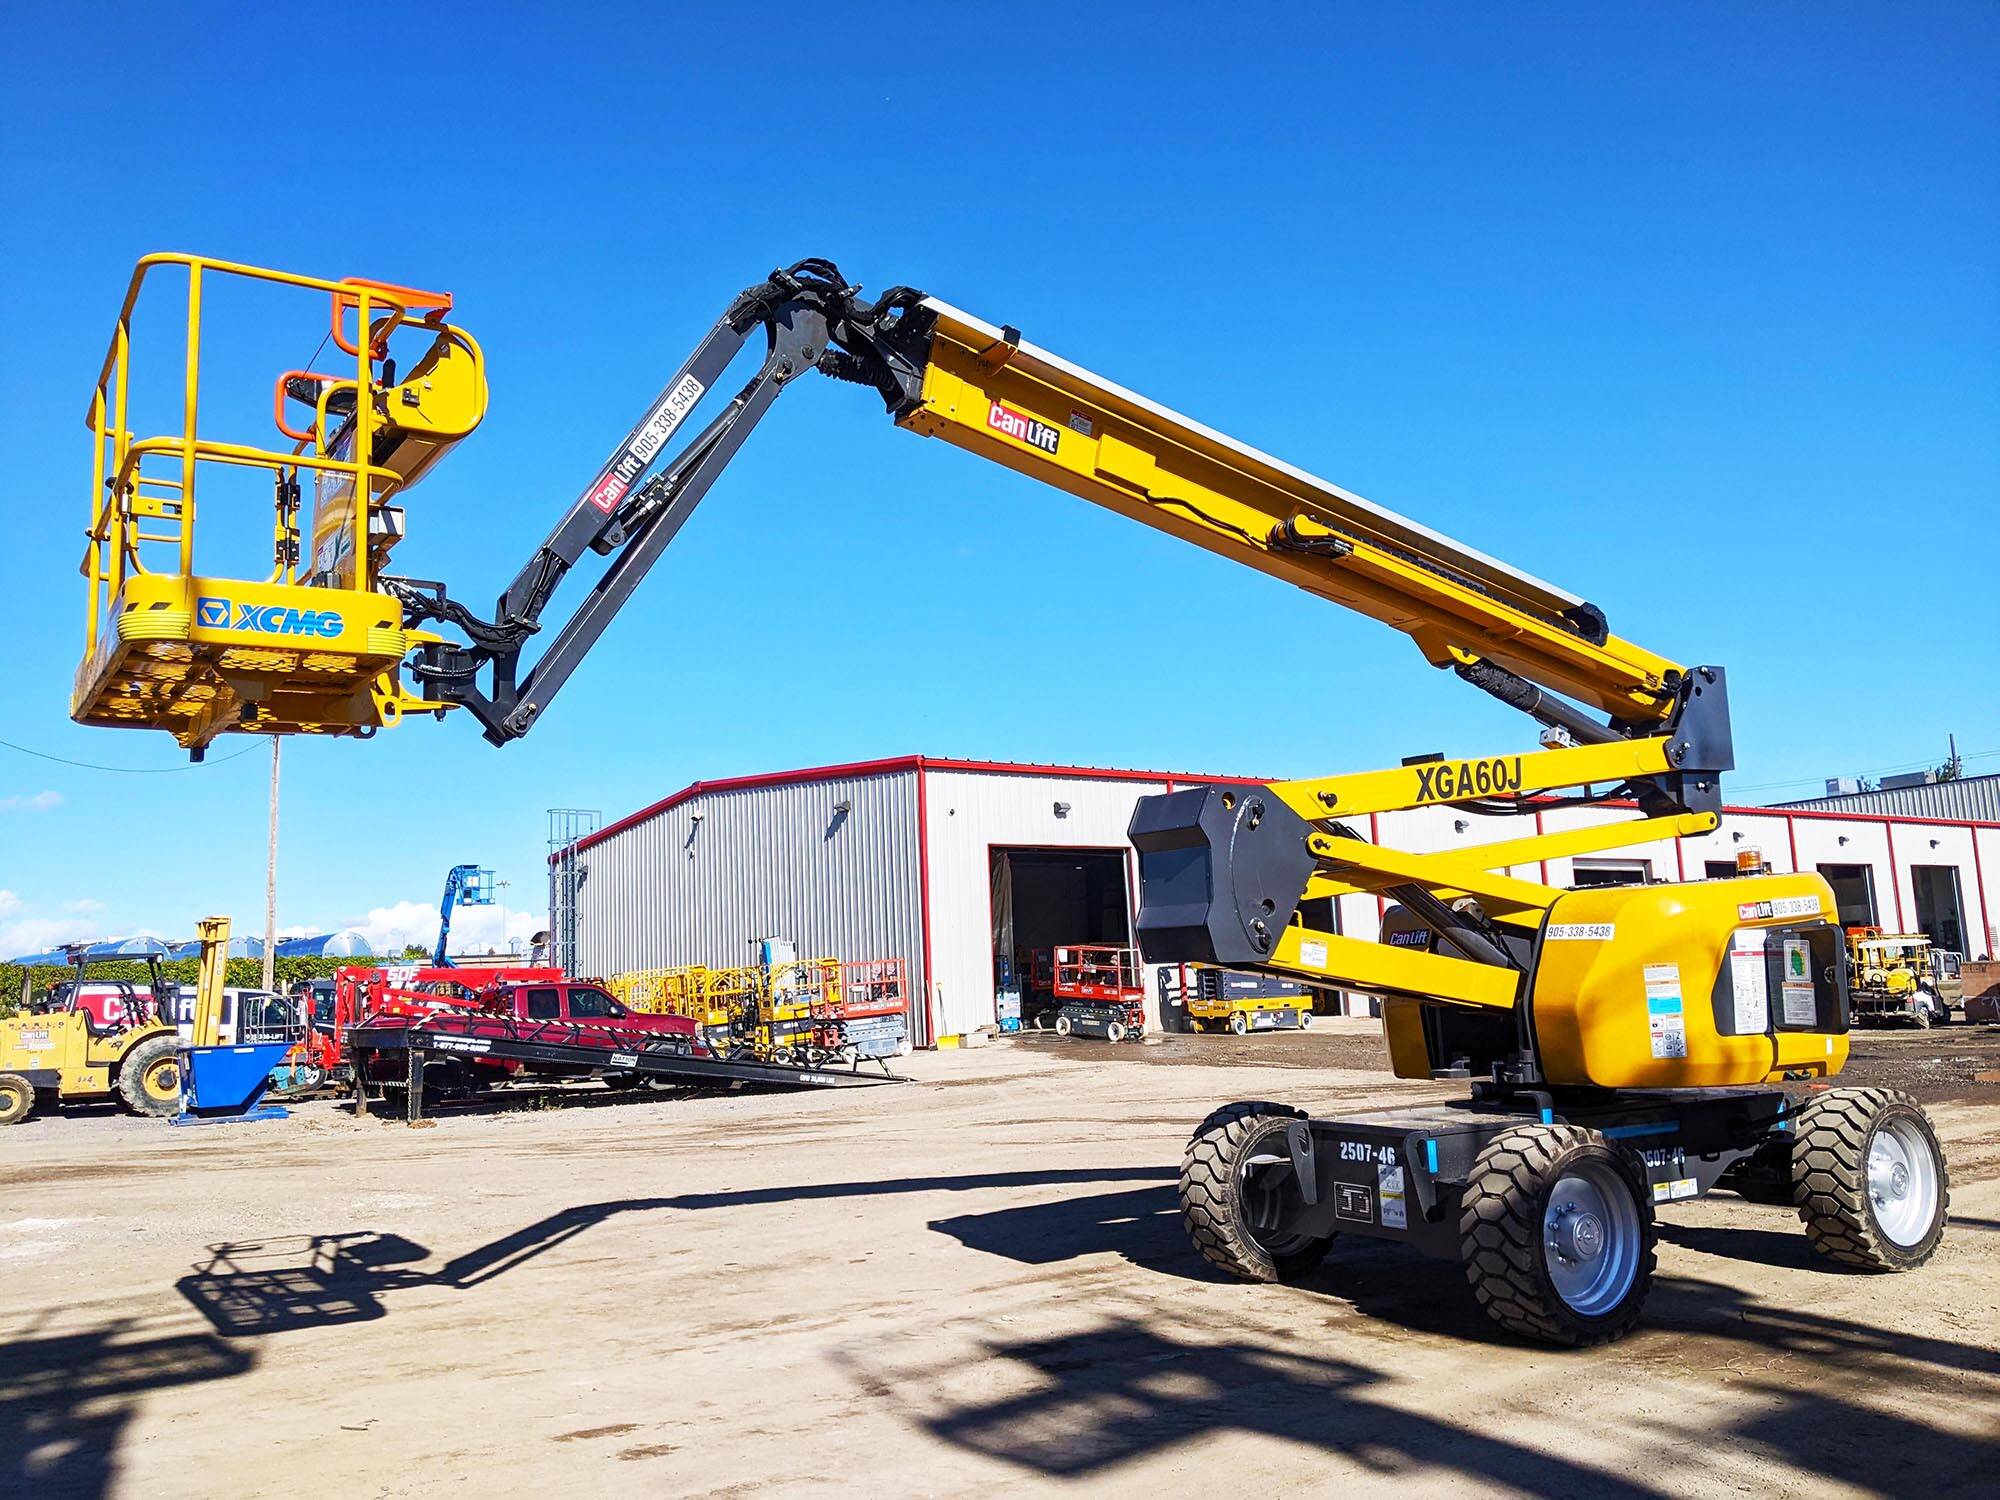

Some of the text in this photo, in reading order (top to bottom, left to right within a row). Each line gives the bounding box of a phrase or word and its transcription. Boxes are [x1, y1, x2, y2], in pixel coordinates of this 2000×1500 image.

[634, 378, 700, 459] 905-338-5438
[230, 604, 345, 638] XCMG
[1416, 757, 1522, 802] XGA60J
[1773, 898, 1819, 915] 905-338-5438
[1547, 926, 1611, 938] 905-338-5438
[1340, 1141, 1396, 1166] 2507-46
[1642, 1146, 1686, 1168] 507-46
